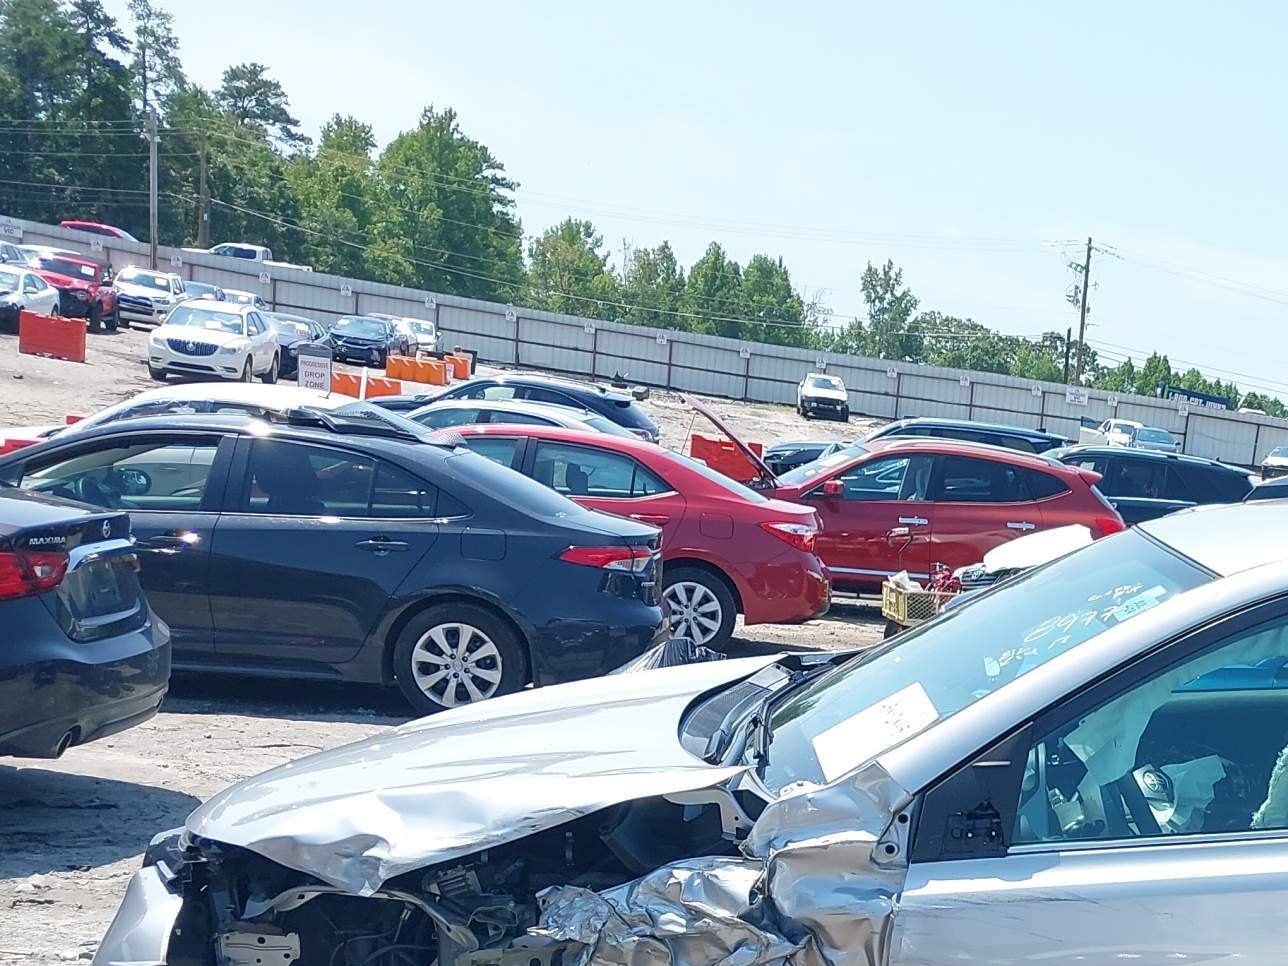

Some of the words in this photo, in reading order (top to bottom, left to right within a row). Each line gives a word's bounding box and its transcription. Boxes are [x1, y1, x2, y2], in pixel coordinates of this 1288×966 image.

[304, 370, 325, 379] DROP
[304, 380, 325, 390] ZONE
[29, 536, 66, 545] MAXIMA
